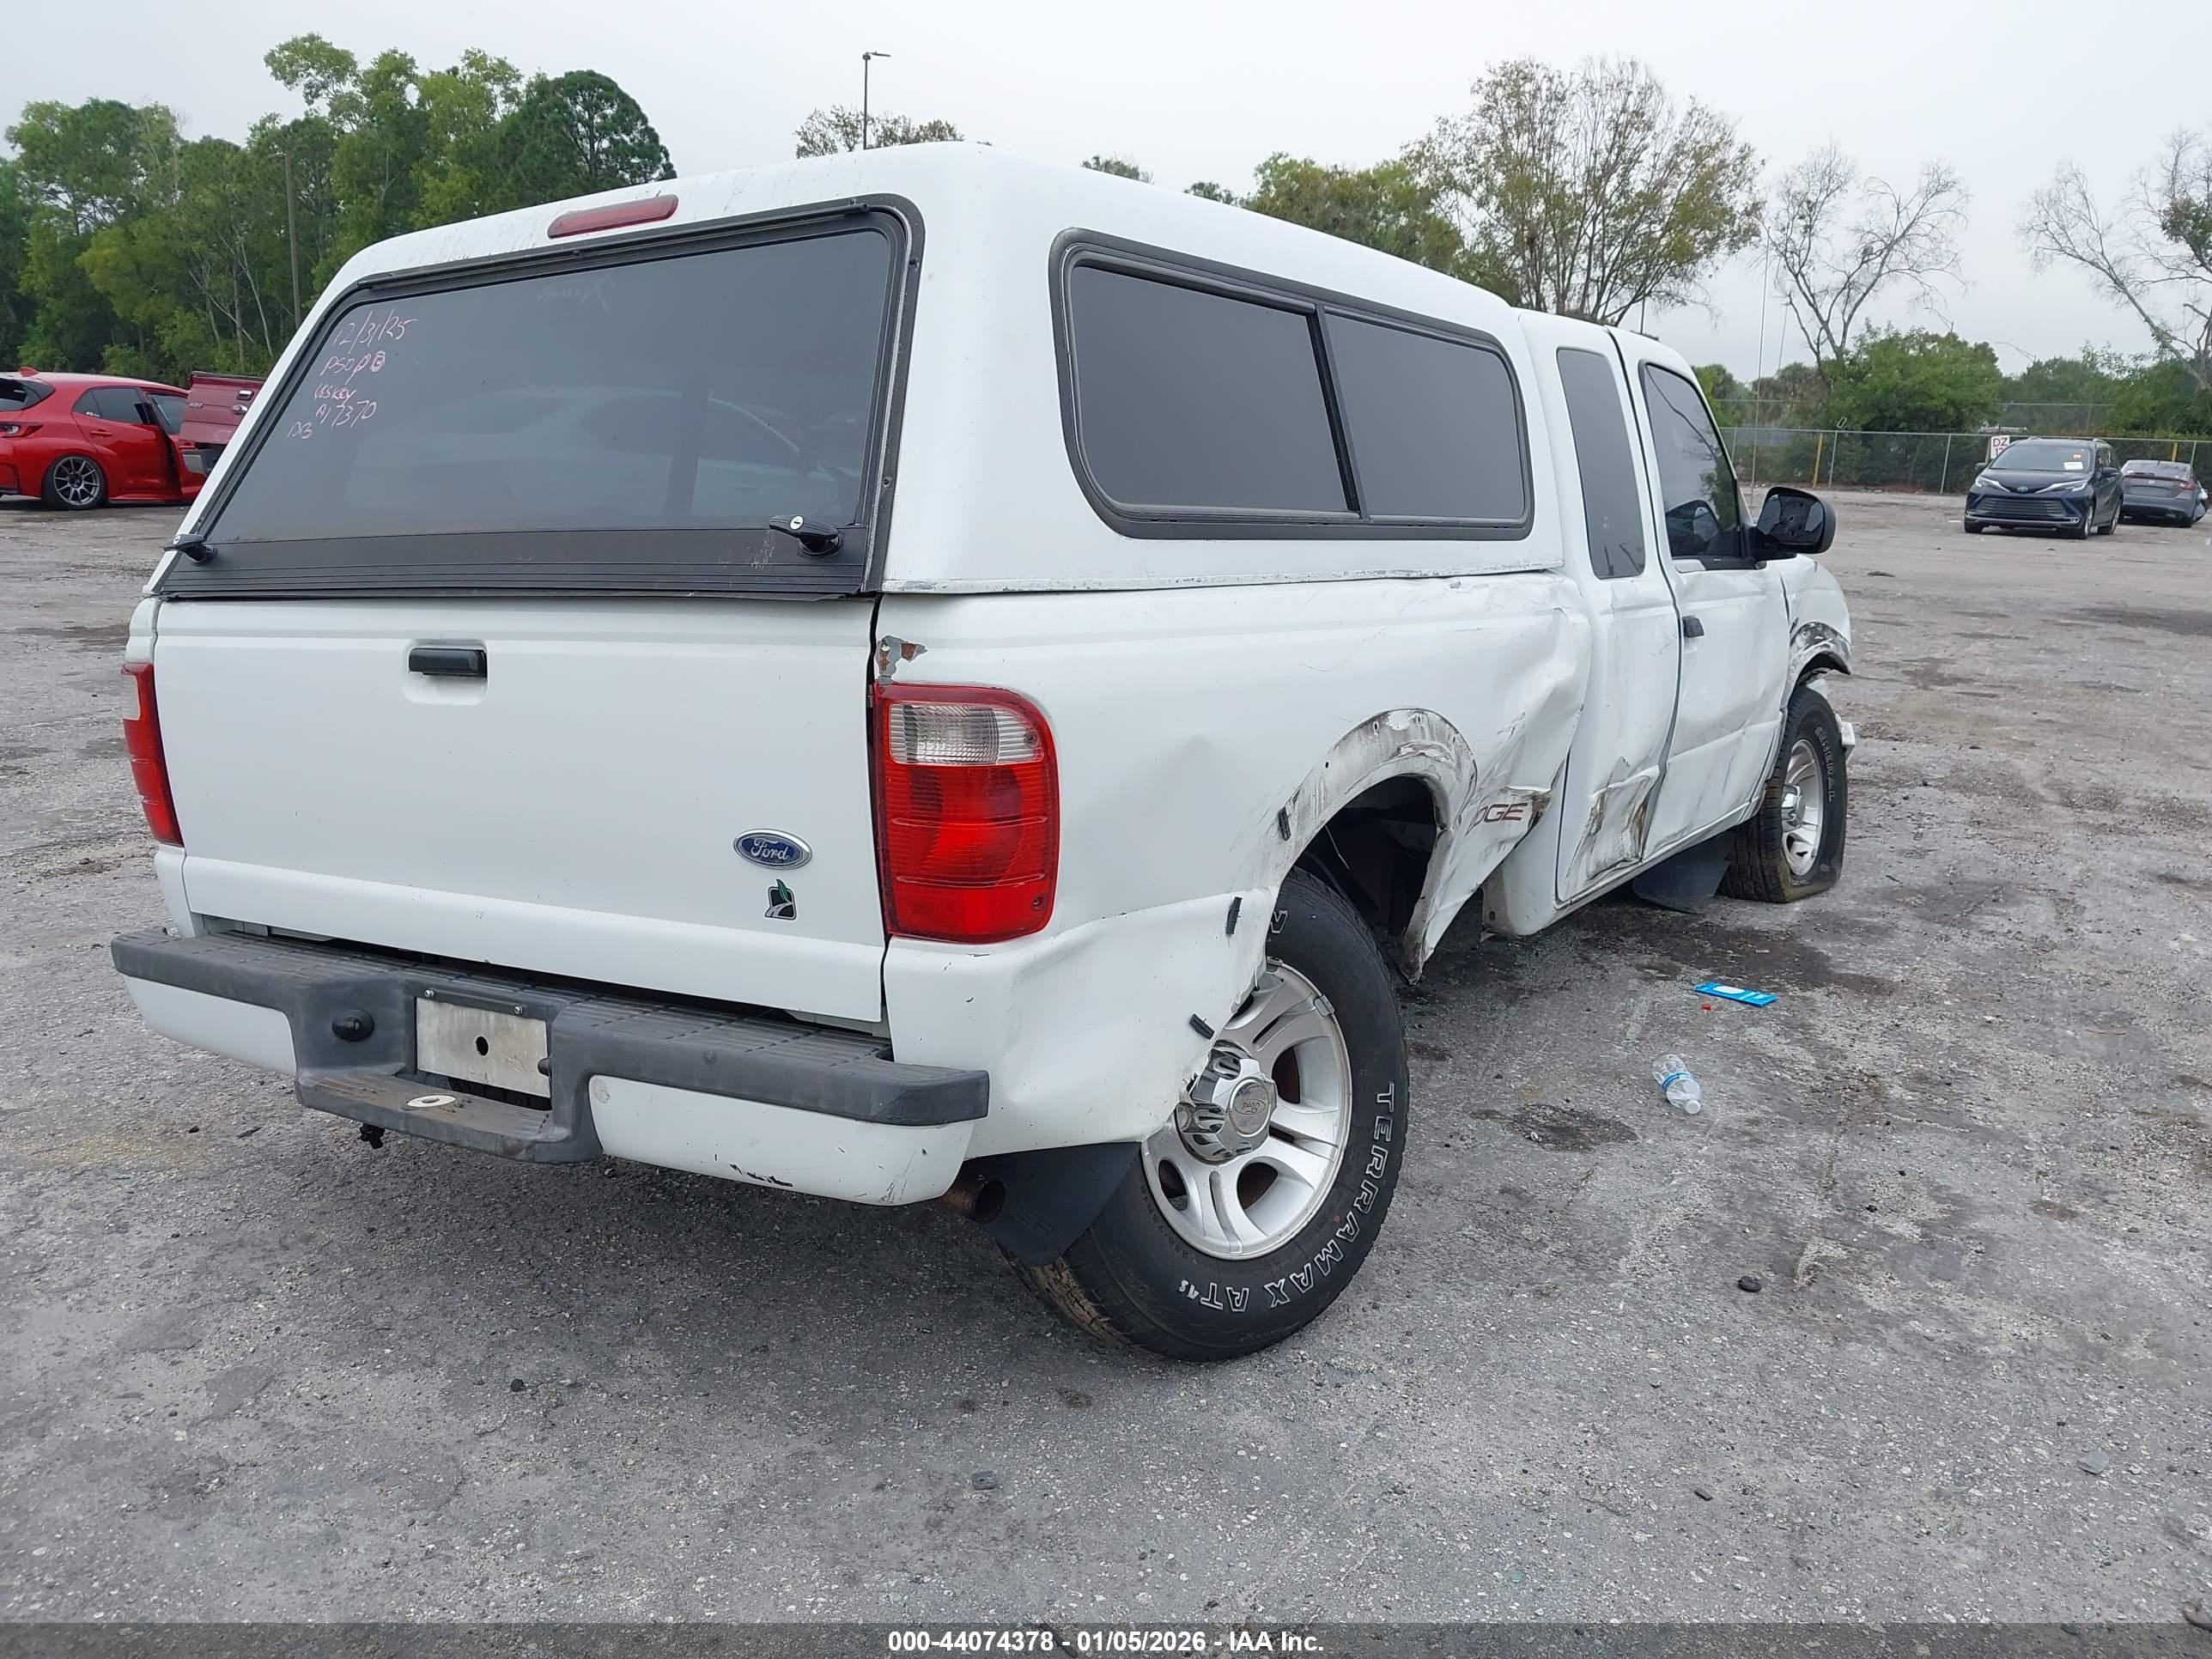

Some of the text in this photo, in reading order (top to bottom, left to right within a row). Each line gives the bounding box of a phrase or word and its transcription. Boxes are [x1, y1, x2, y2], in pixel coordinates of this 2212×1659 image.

[332, 308, 418, 354] 12/31/25
[1993, 438, 2008, 447] DZ
[750, 837, 789, 860] Ford
[1264, 1081, 1395, 1309] TERRAMAX
